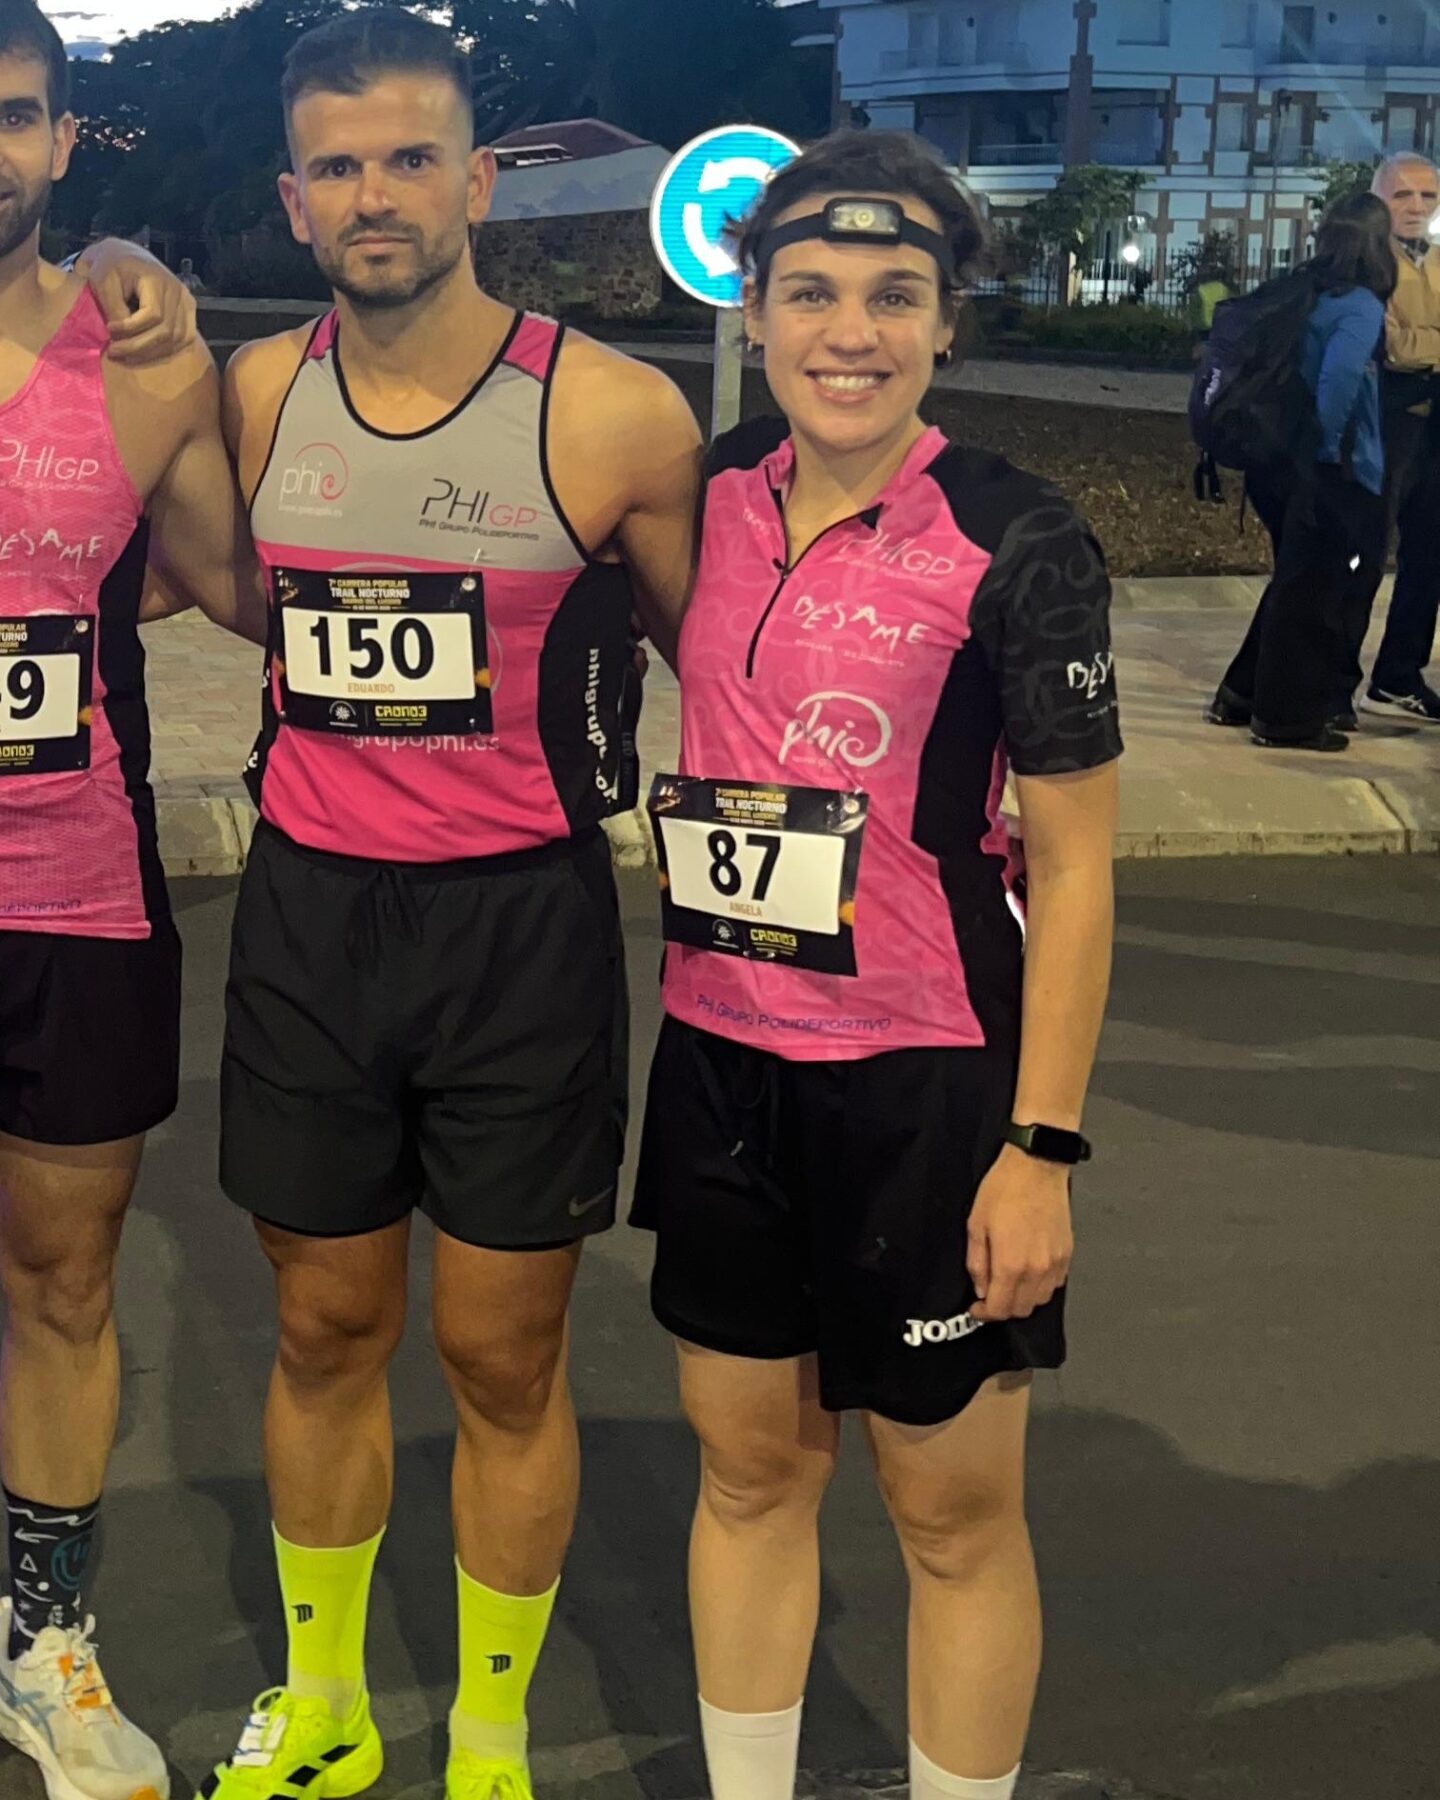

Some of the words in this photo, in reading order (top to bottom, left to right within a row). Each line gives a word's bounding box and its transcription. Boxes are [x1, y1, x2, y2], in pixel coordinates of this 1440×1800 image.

[331, 588, 357, 598] TRAIL
[358, 588, 411, 599] NOCTURNO
[309, 615, 435, 680] 150
[347, 683, 396, 694] EDUARDO
[715, 797, 735, 809] TRAIL
[736, 799, 788, 814] NOCTURNO
[707, 829, 782, 901] 87
